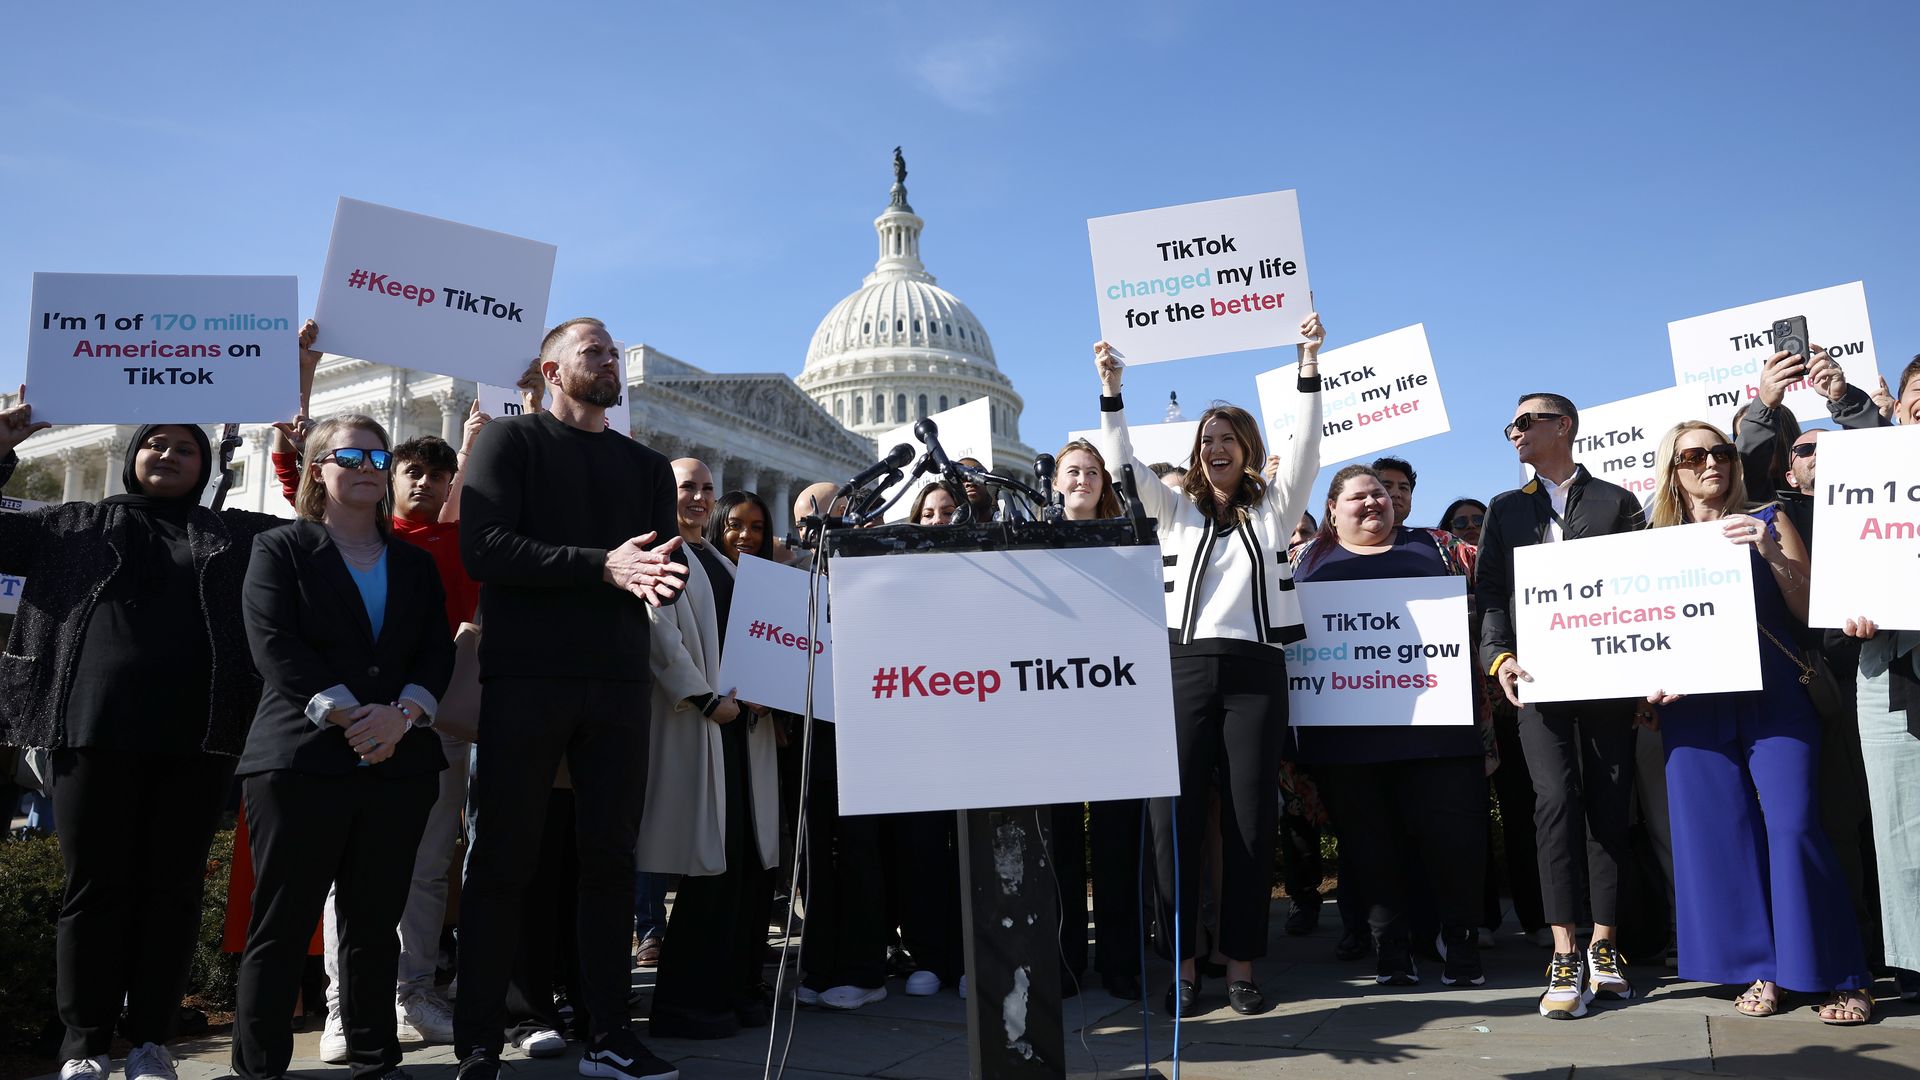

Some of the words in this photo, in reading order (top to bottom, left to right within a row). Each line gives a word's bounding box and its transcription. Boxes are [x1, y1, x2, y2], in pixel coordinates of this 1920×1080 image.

[1157, 234, 1237, 261] TikTok
[1107, 268, 1211, 300] changed
[1217, 266, 1253, 286] my
[1259, 257, 1296, 279] life
[348, 269, 435, 306] #Keep
[443, 287, 524, 322] TikTok
[43, 312, 87, 330] I'm
[94, 314, 106, 330] 1
[115, 314, 144, 330] of
[151, 314, 196, 330] 170
[204, 314, 288, 331] million
[1125, 309, 1159, 328] for
[1165, 303, 1205, 322] the
[1210, 293, 1285, 316] better
[73, 340, 221, 357] Americans
[228, 344, 260, 357] on
[1730, 329, 1774, 351] TikT
[124, 367, 214, 384] TikTok
[1321, 366, 1376, 391] ikTok
[1684, 358, 1758, 384] helped
[1273, 392, 1357, 430] chged
[1361, 384, 1391, 402] my
[1396, 373, 1428, 392] life
[1708, 390, 1740, 406] my
[1322, 419, 1353, 437] the
[1357, 399, 1420, 426] better
[1575, 426, 1644, 454] TikTok
[1603, 455, 1636, 473] me
[1828, 483, 1874, 505] I'm
[1884, 481, 1896, 502] 1
[1524, 587, 1558, 605] I'm
[1563, 583, 1573, 600] 1
[1580, 579, 1604, 599] of
[1610, 574, 1650, 595] 170
[1657, 568, 1741, 591] million
[1322, 612, 1400, 632] TikTok
[1550, 605, 1676, 630] Americans
[1682, 601, 1715, 618] on
[1285, 642, 1347, 666] elped
[1354, 644, 1391, 659] me
[1397, 643, 1460, 664] grow
[1591, 632, 1672, 655] TikTok
[872, 665, 1001, 702] #Keep
[1010, 656, 1137, 691] TikTok
[1290, 676, 1325, 695] my
[1332, 670, 1438, 689] business
